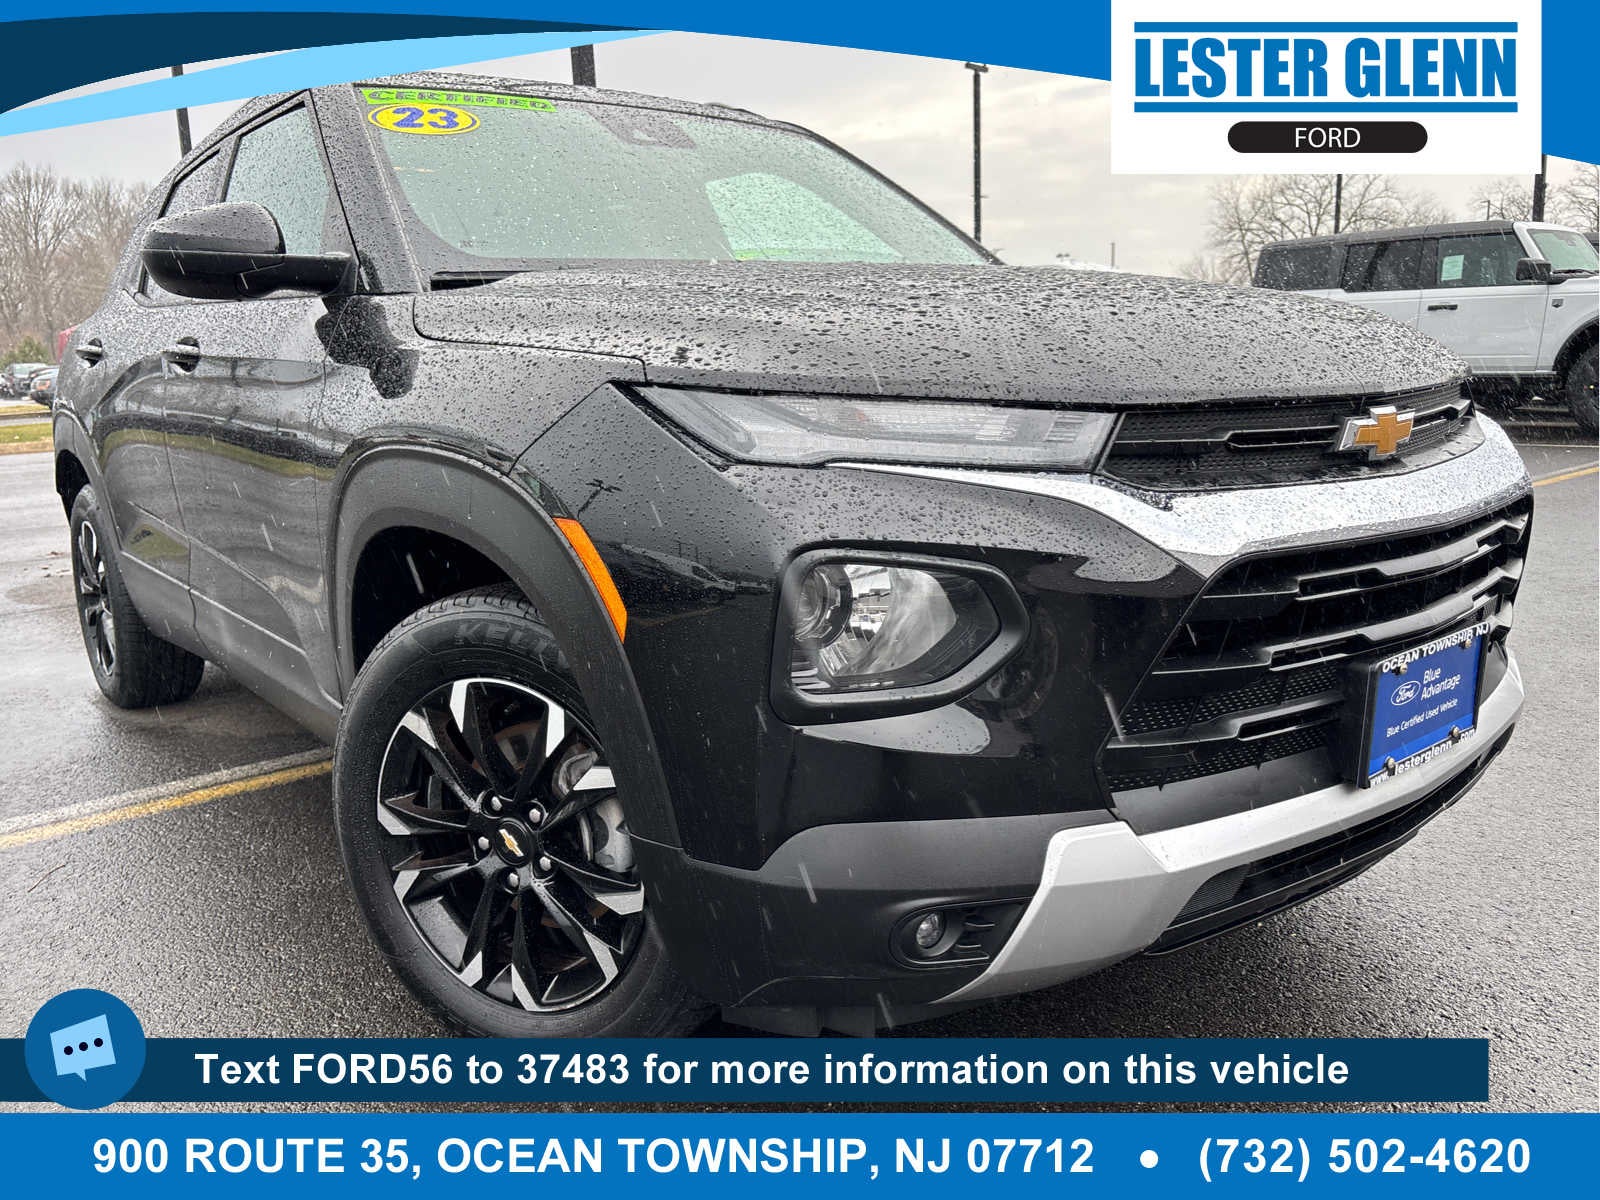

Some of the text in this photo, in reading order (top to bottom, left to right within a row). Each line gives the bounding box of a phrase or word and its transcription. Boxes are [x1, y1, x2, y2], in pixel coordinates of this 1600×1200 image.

[392, 106, 460, 130] 23
[1382, 622, 1491, 674] OCEAN TOWNSHIP NJ
[1420, 674, 1462, 701] Advantage
[1422, 667, 1442, 685] Blue
[1386, 698, 1459, 738] Blue Certified Used Vehicle
